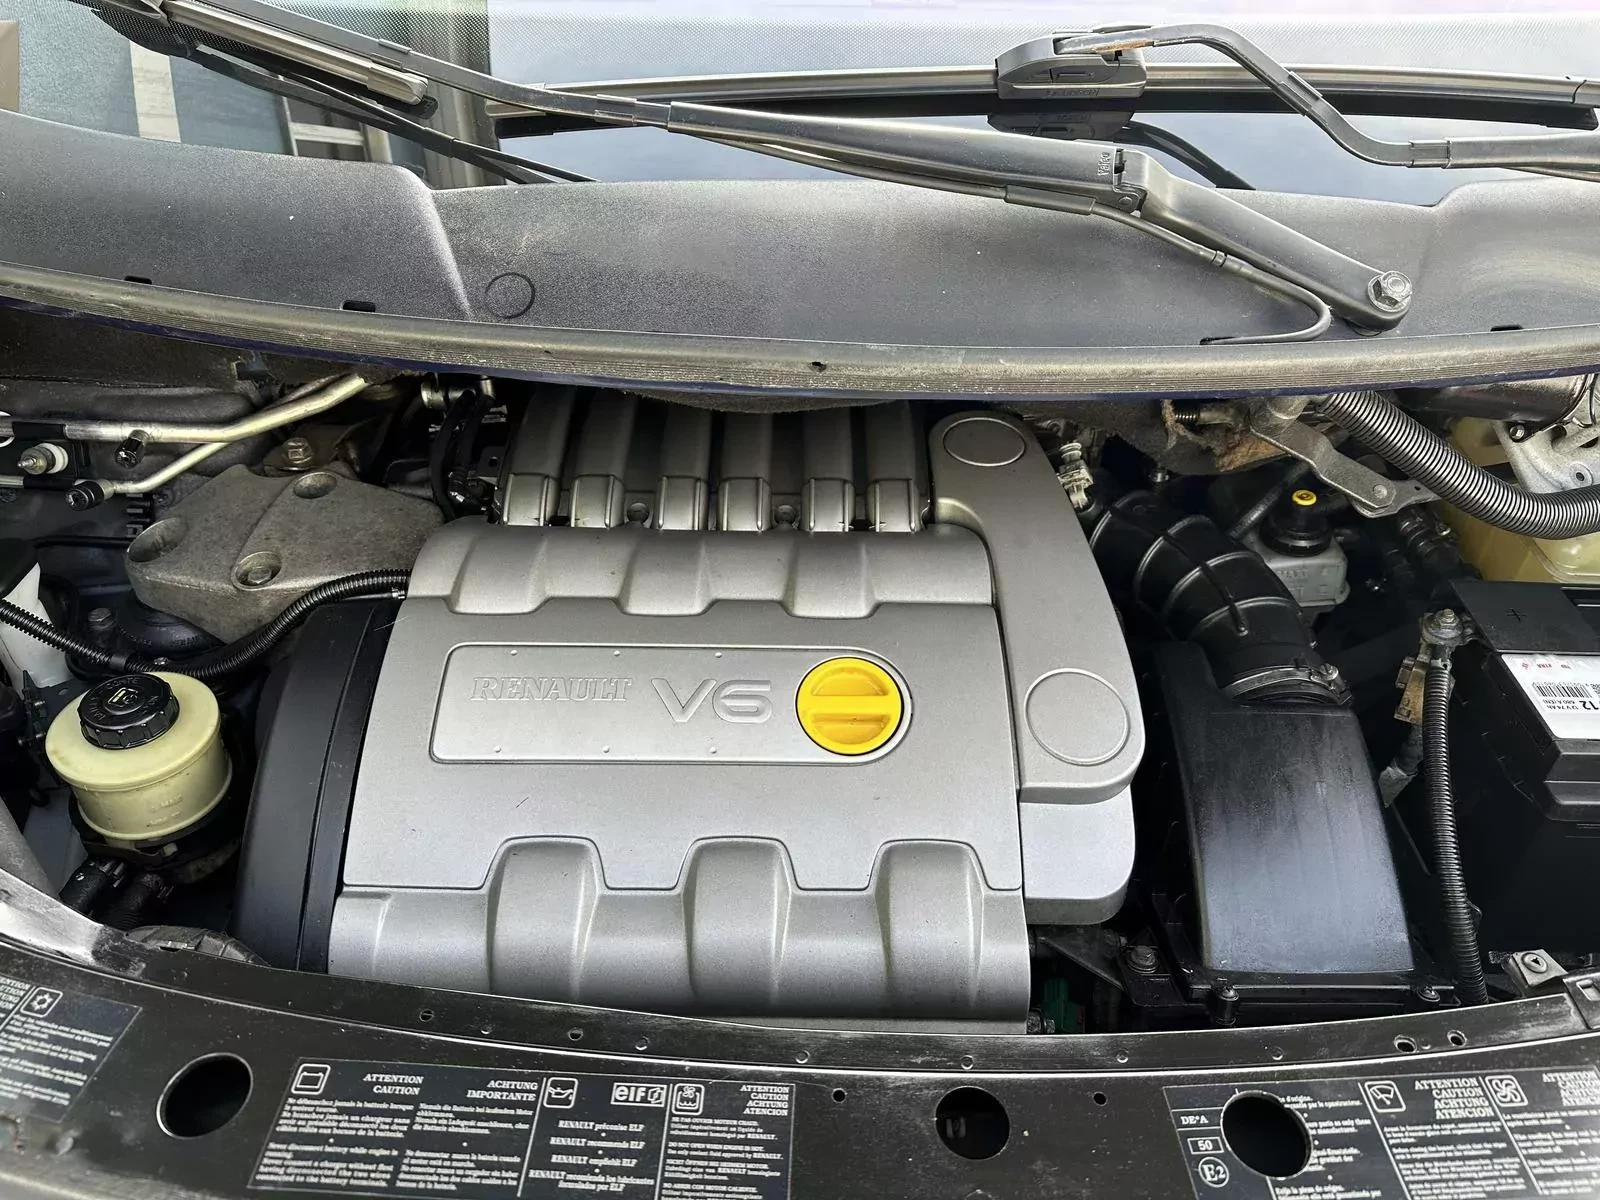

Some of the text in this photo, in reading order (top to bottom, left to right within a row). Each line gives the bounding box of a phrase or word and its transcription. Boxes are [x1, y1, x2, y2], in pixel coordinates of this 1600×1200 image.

[1097, 151, 1111, 176] Valeo
[469, 676, 773, 724] RENAULT V6
[363, 1074, 424, 1084] ATTENTION
[1415, 1078, 1479, 1090] ATTENTION
[372, 1084, 420, 1095] CAUTION
[487, 1080, 539, 1090] ACHTUNG
[740, 1084, 790, 1093] ATTENTION
[467, 1090, 537, 1102] IMPORTANTE
[750, 1092, 789, 1101] CAUTION
[1432, 1087, 1484, 1098] CAUTION
[746, 1100, 789, 1108] ACHTUNG
[1434, 1097, 1489, 1109] ACHTUNG
[744, 1108, 788, 1116] ATENCION
[1436, 1107, 1494, 1119] ATENCION
[558, 1121, 595, 1129] RENAULT
[550, 1138, 587, 1146] RENAULT
[1198, 1140, 1213, 1150] 50
[551, 1156, 588, 1164] RENAULT
[528, 1170, 566, 1179] RENAULT
[1202, 1164, 1226, 1181] E2
